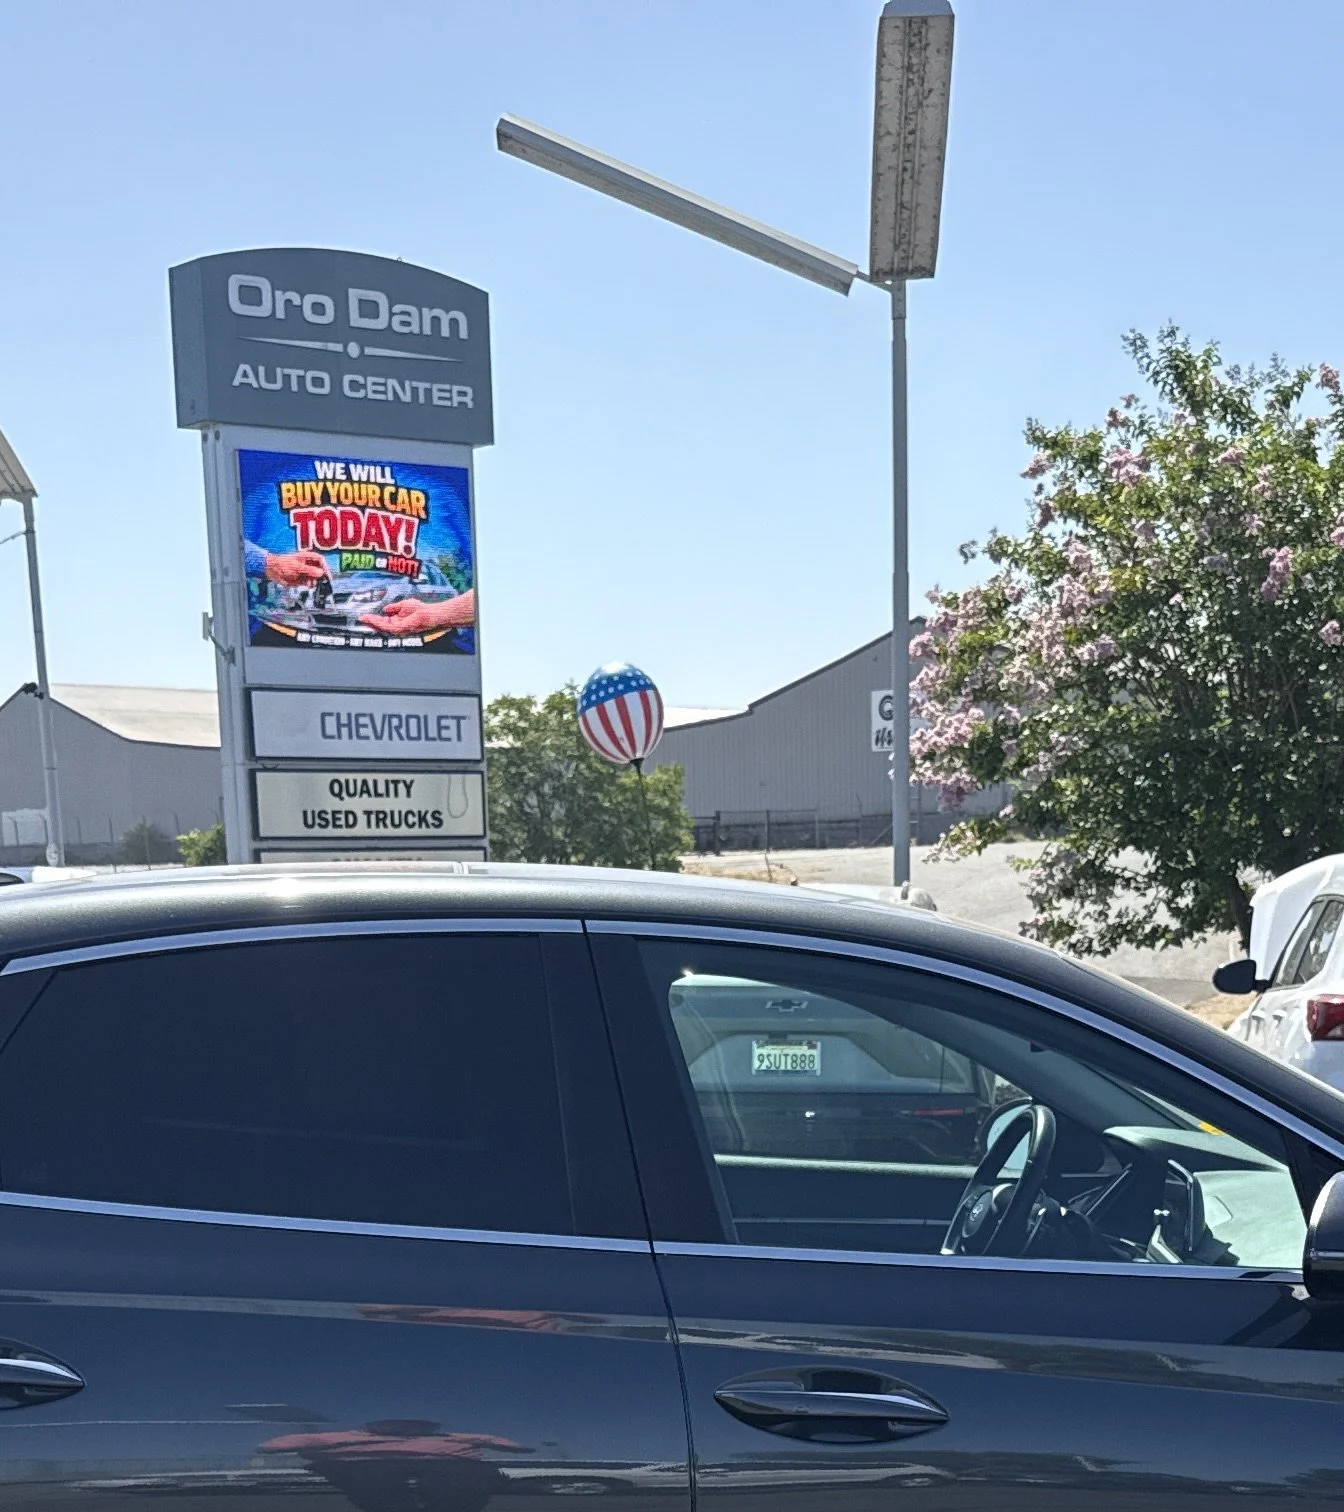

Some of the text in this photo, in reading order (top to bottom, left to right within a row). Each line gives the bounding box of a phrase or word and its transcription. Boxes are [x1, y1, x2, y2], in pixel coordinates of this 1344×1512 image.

[228, 274, 469, 339] Oro Dam
[232, 363, 474, 409] AUTO CENTER
[314, 460, 396, 485] WE WILL
[280, 481, 427, 519] BUY YOUR CAR
[292, 508, 417, 556] TODAY!
[342, 552, 375, 570] PAID
[320, 712, 467, 743] CHEVROLET
[329, 778, 415, 800] QUALITY
[302, 809, 444, 829] USED TRUCKS
[756, 1053, 816, 1070] 9SUT888
